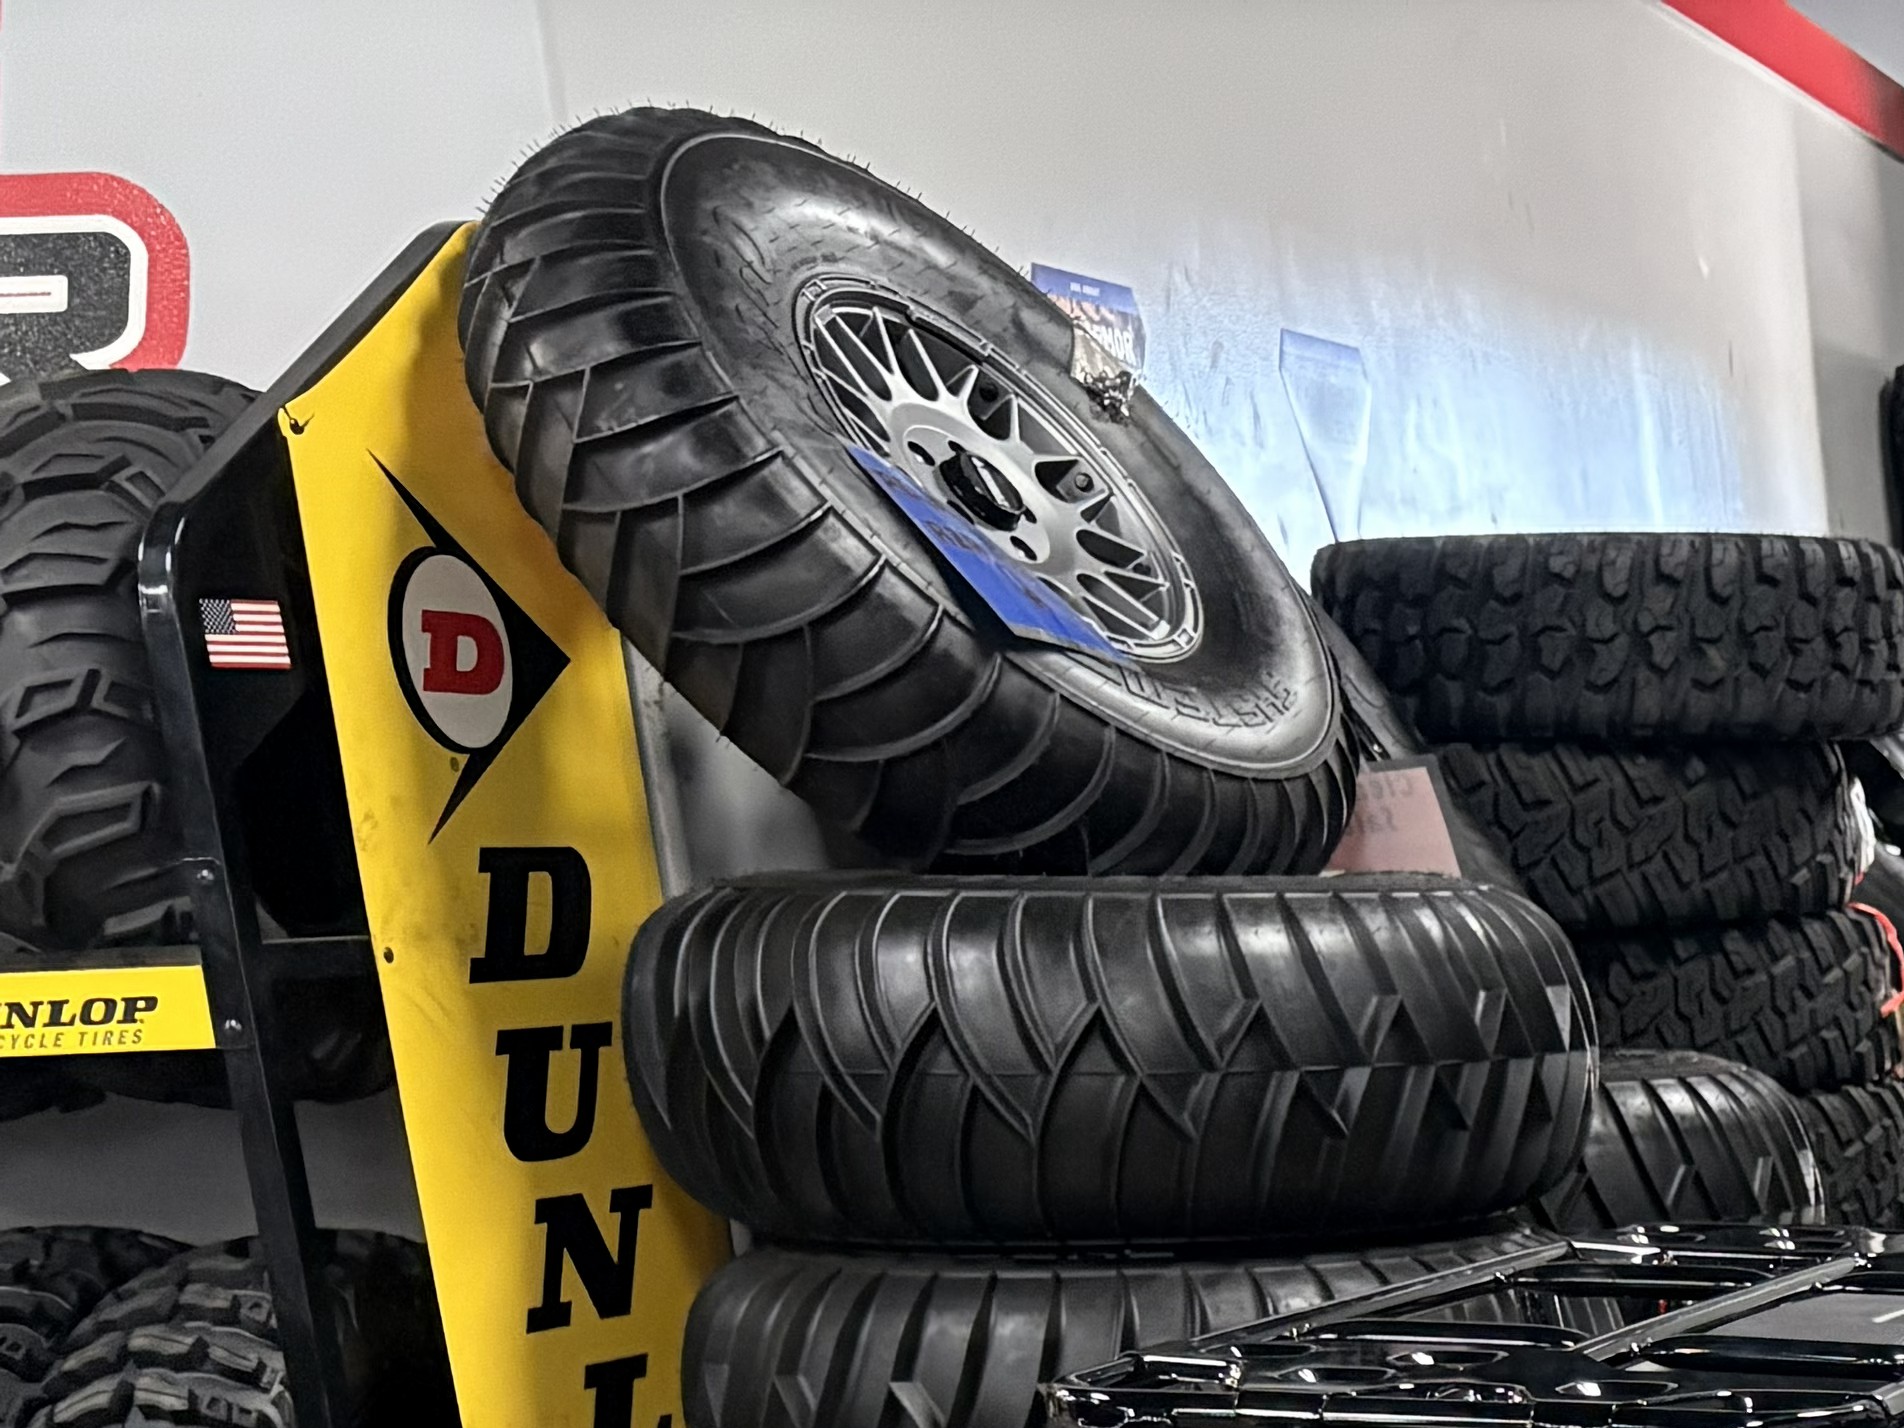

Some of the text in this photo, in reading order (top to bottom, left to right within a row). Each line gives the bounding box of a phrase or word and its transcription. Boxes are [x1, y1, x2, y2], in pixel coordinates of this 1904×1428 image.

[420, 611, 506, 695] D
[0, 996, 159, 1029] NLOP
[78, 1029, 144, 1046] TIRES
